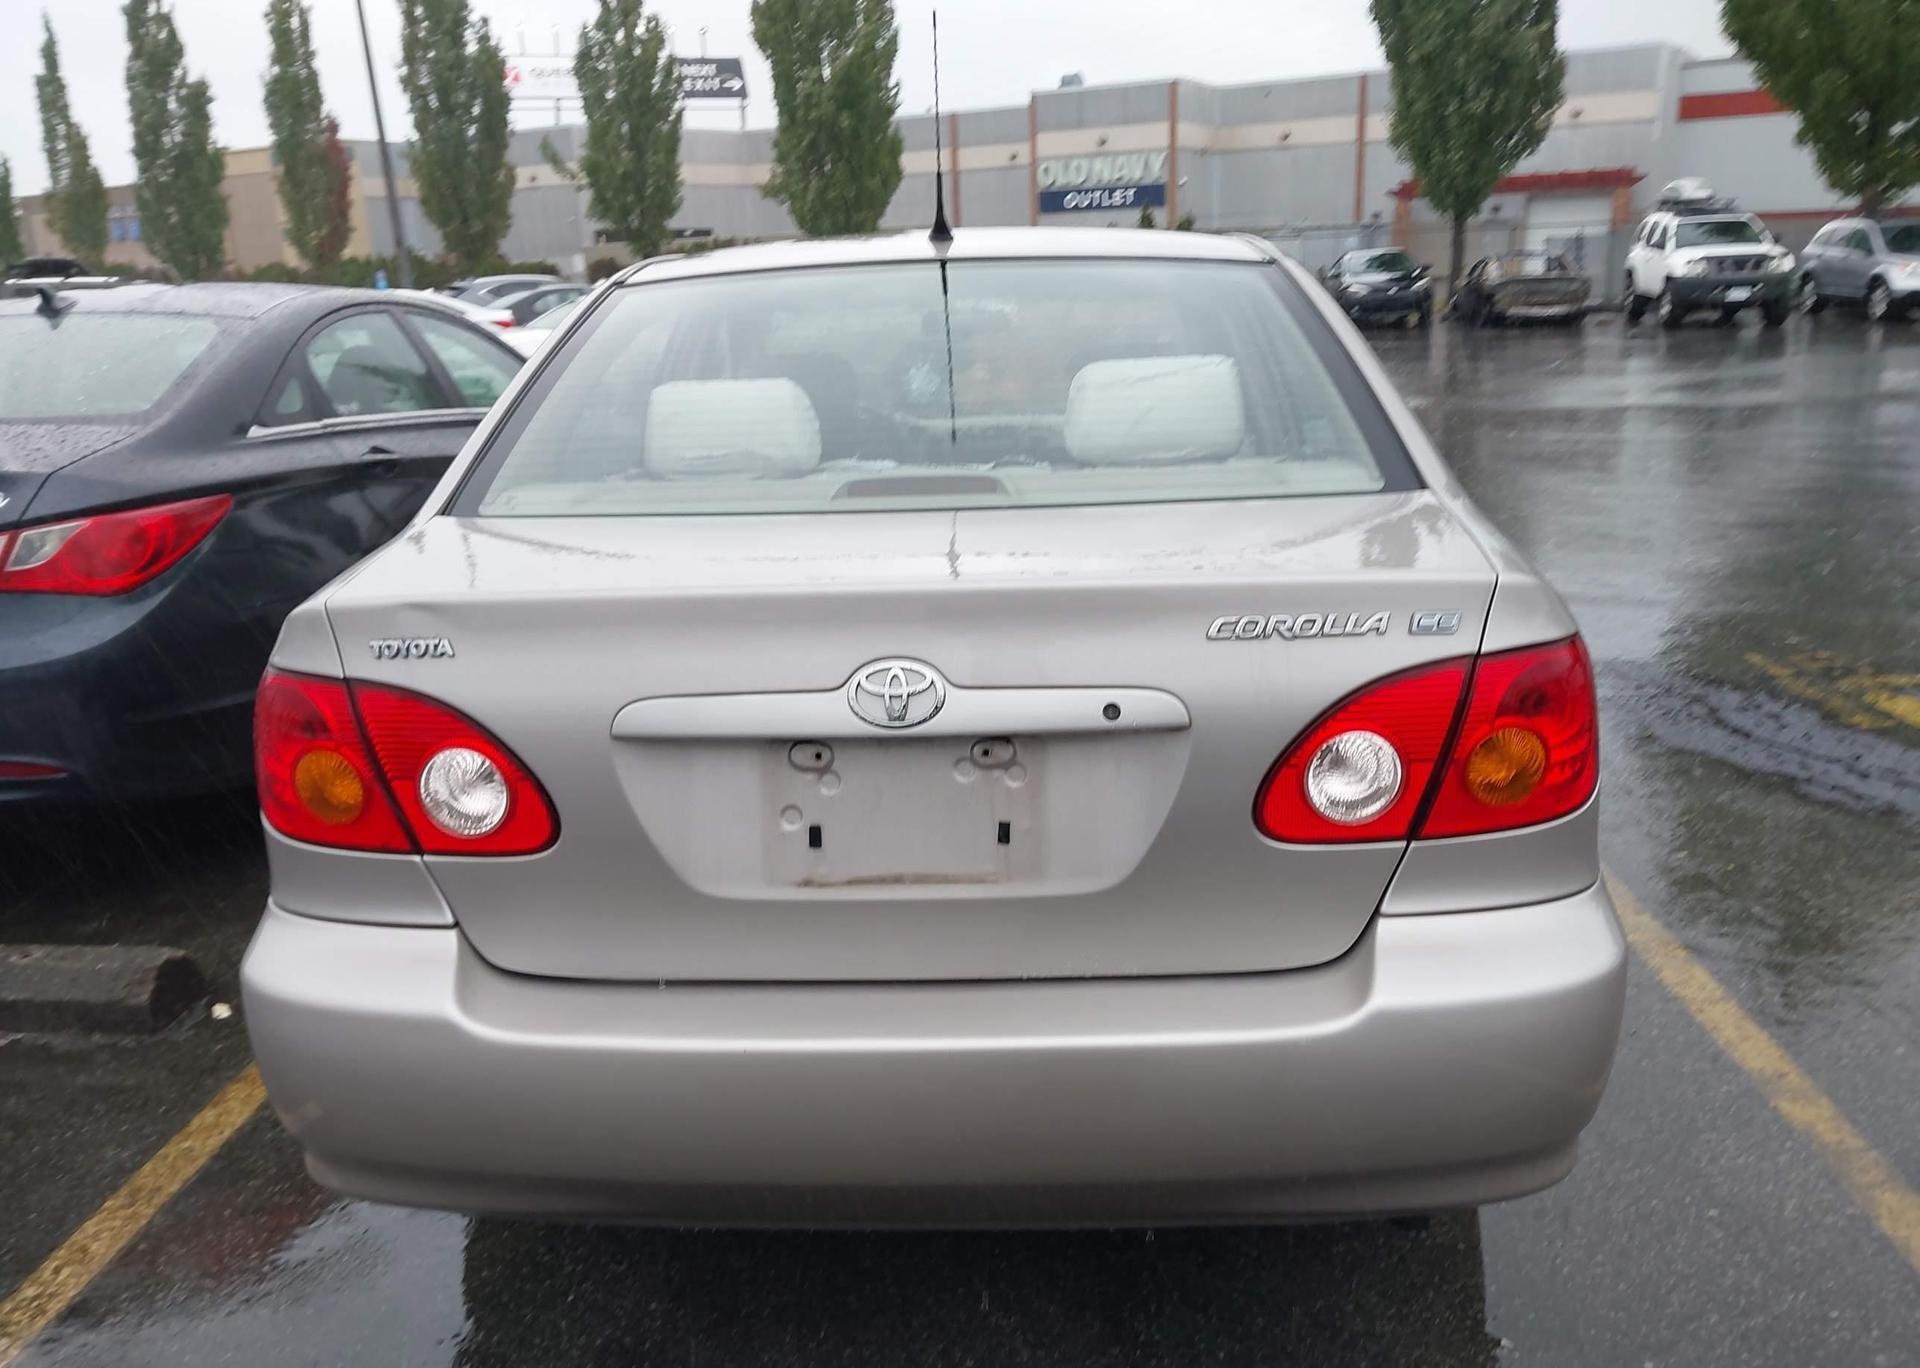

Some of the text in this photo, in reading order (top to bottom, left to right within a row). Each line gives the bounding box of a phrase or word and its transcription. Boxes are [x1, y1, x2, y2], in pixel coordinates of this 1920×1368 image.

[1037, 151, 1168, 189] OLD NAVY
[1063, 187, 1138, 209] OUTLET
[1206, 611, 1391, 640] COROLLA
[369, 637, 455, 659] TOYOTA
